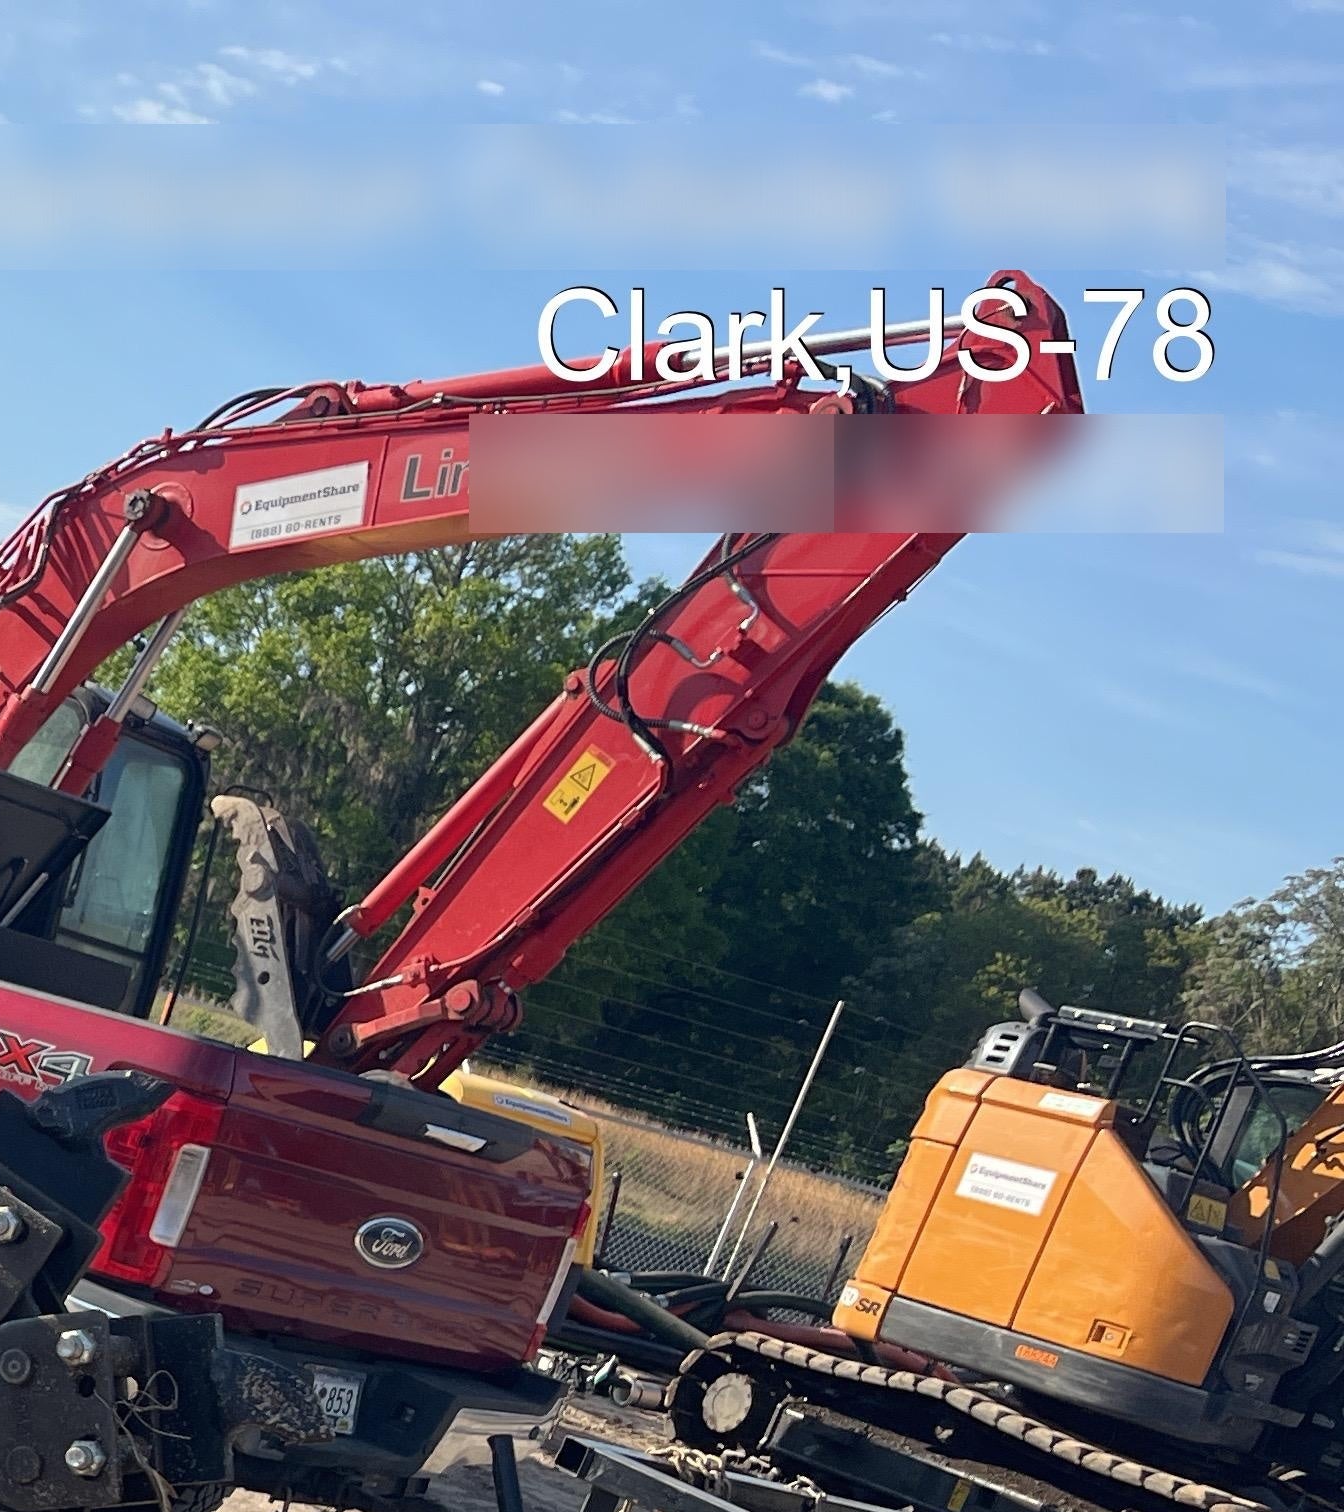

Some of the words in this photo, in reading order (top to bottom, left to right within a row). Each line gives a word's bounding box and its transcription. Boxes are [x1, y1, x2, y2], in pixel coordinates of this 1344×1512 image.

[254, 483, 360, 512] EquipmentShare
[250, 525, 282, 540] (888)
[285, 515, 341, 533] 80-RENTS
[978, 1165, 1047, 1190] EquipmentShare
[372, 1227, 411, 1259] Ford
[855, 1298, 881, 1316] SR
